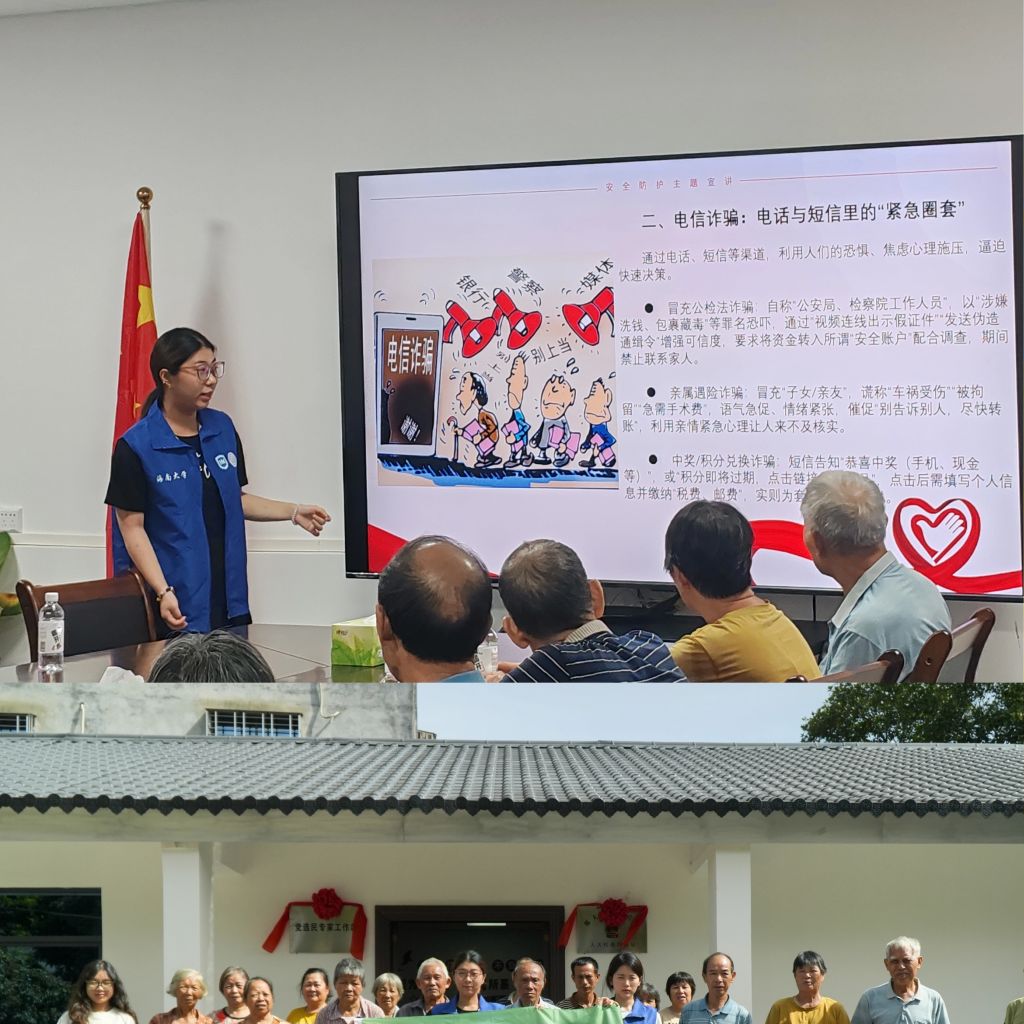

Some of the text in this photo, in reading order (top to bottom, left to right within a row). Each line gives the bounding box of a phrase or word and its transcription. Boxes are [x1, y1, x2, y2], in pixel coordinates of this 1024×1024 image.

[606, 176, 733, 192] 安全防护主题宣讲
[642, 199, 965, 229] 二、电信诈骗：电话与短信里的“紧急圈套”
[507, 267, 545, 295] 警察
[619, 268, 674, 282] 快速决策。
[456, 275, 490, 304] 银行
[387, 333, 434, 377] 电信诈骗
[531, 337, 571, 364] 别上当
[620, 352, 699, 366] 禁止联系家人。
[156, 470, 187, 483] 海南大学
